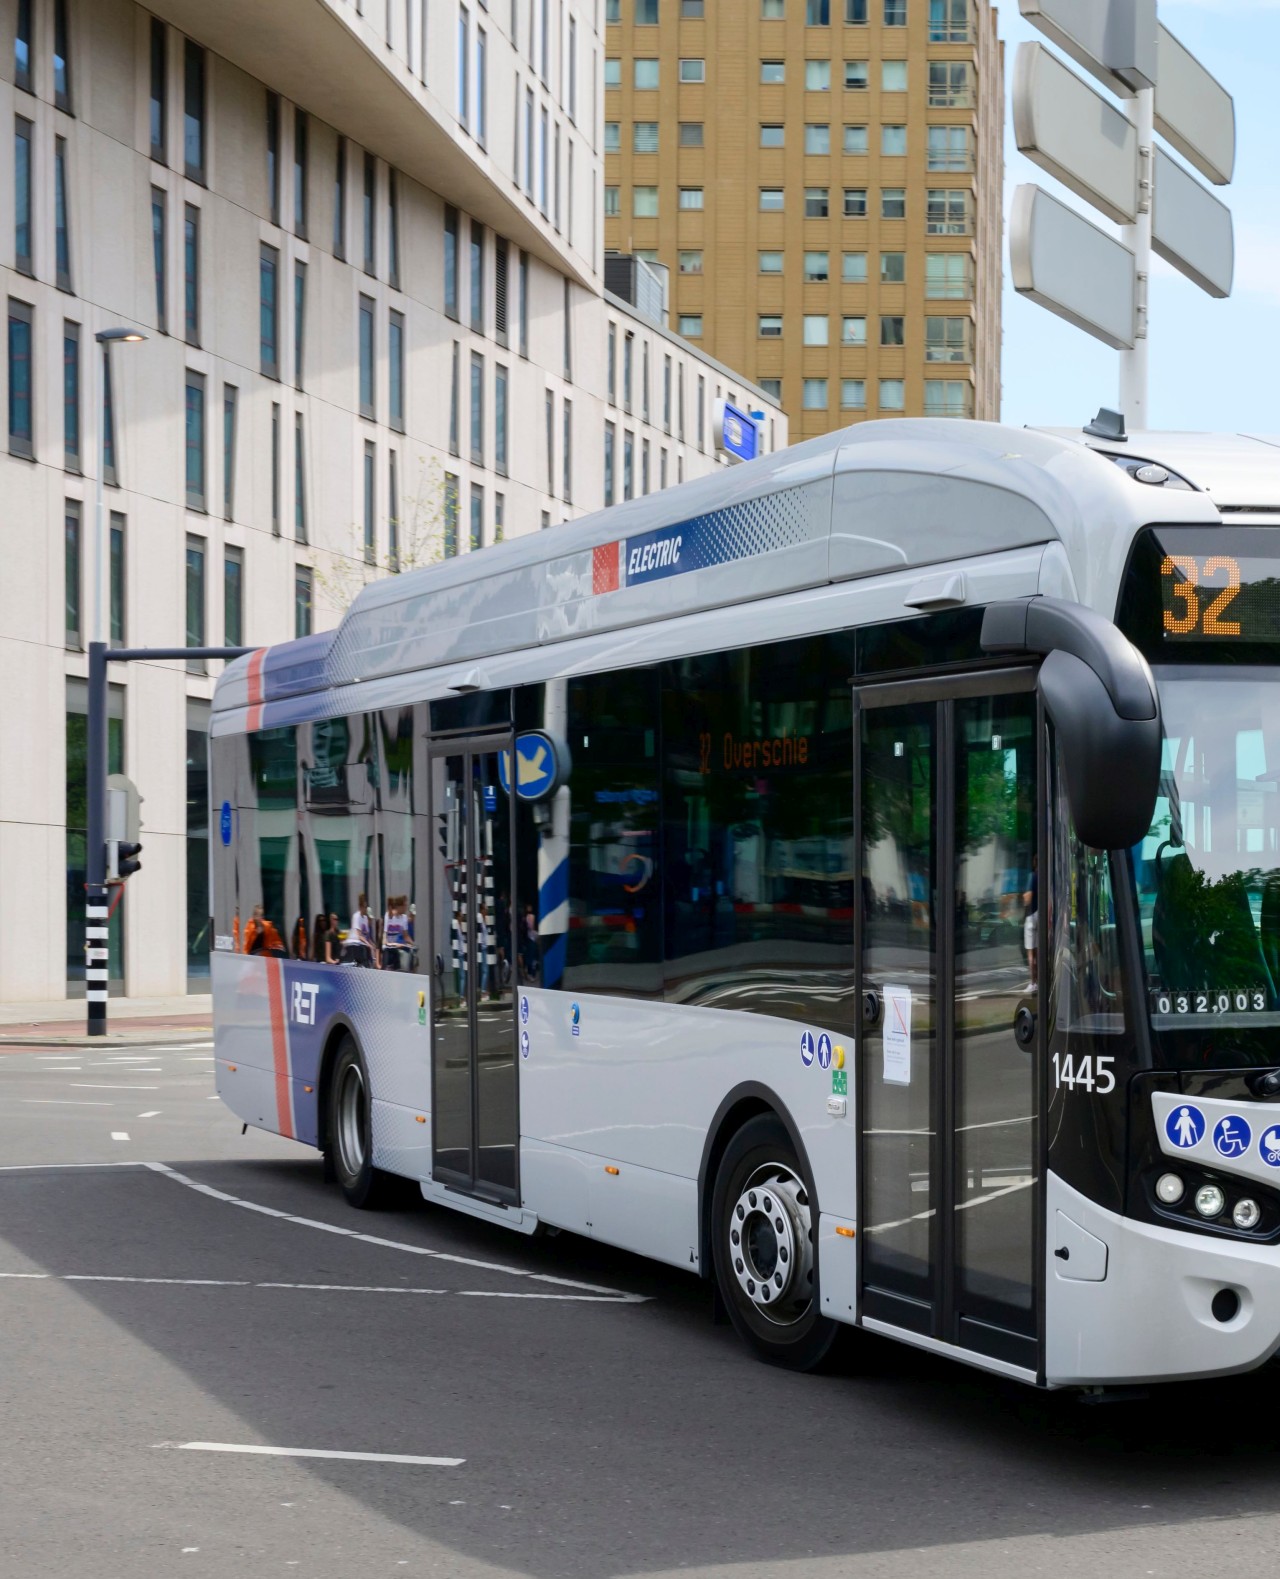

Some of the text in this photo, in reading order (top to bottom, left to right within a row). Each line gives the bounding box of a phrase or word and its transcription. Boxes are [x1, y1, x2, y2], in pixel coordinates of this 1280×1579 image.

[627, 535, 683, 575] ELECTRIC
[1160, 555, 1241, 636] 32
[723, 726, 809, 770] Overschie
[290, 981, 320, 1026] RET
[1052, 1052, 1116, 1094] 1445
